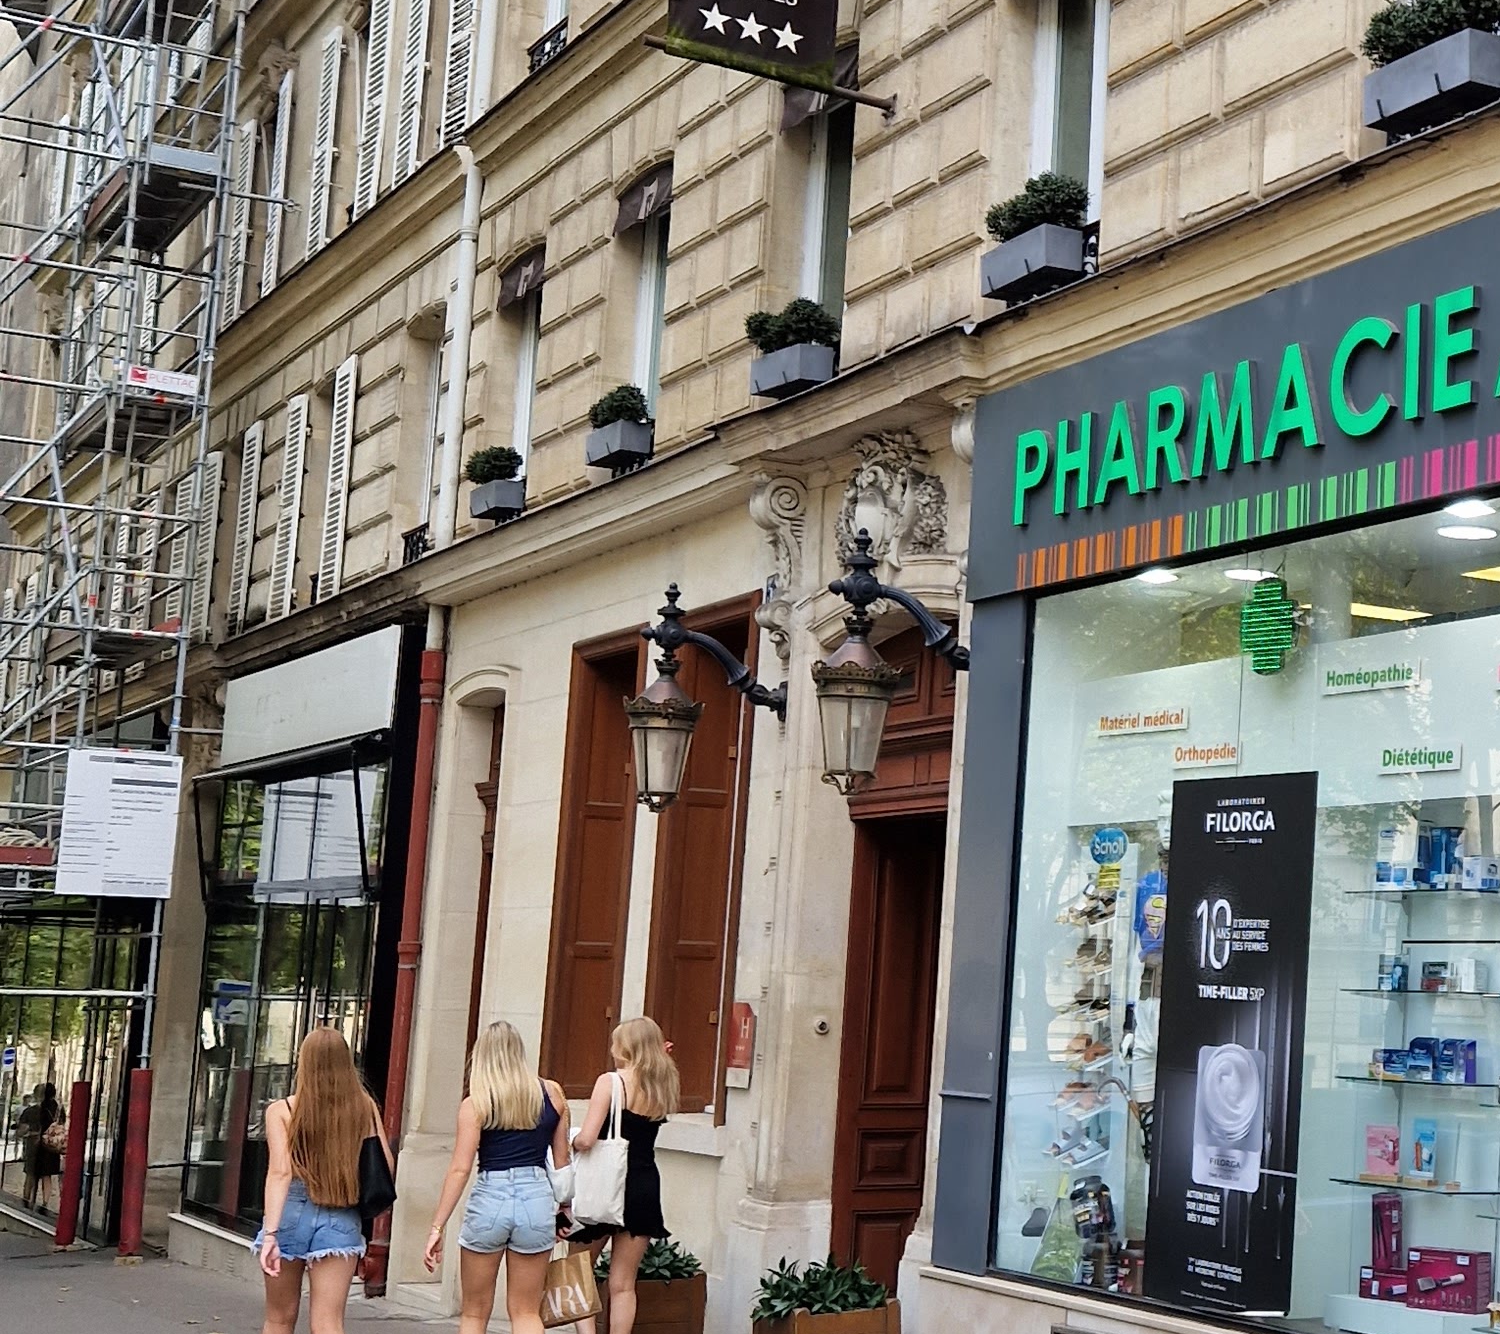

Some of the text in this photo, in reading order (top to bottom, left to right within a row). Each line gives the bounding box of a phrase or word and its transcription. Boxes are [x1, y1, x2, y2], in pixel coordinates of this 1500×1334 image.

[1012, 284, 1482, 527] PHARMACIE
[1326, 663, 1414, 689] Homéopathie
[1099, 708, 1185, 732] Matériel médical
[1174, 743, 1238, 764] Orthopédie
[1382, 748, 1455, 770] Diététique
[1205, 810, 1276, 834] FILORGA
[1094, 836, 1125, 855] Scholl
[1196, 898, 1233, 970] 10
[1215, 928, 1232, 941] ANS
[1198, 983, 1250, 1001] TIME-FILLER
[740, 1016, 750, 1039] H
